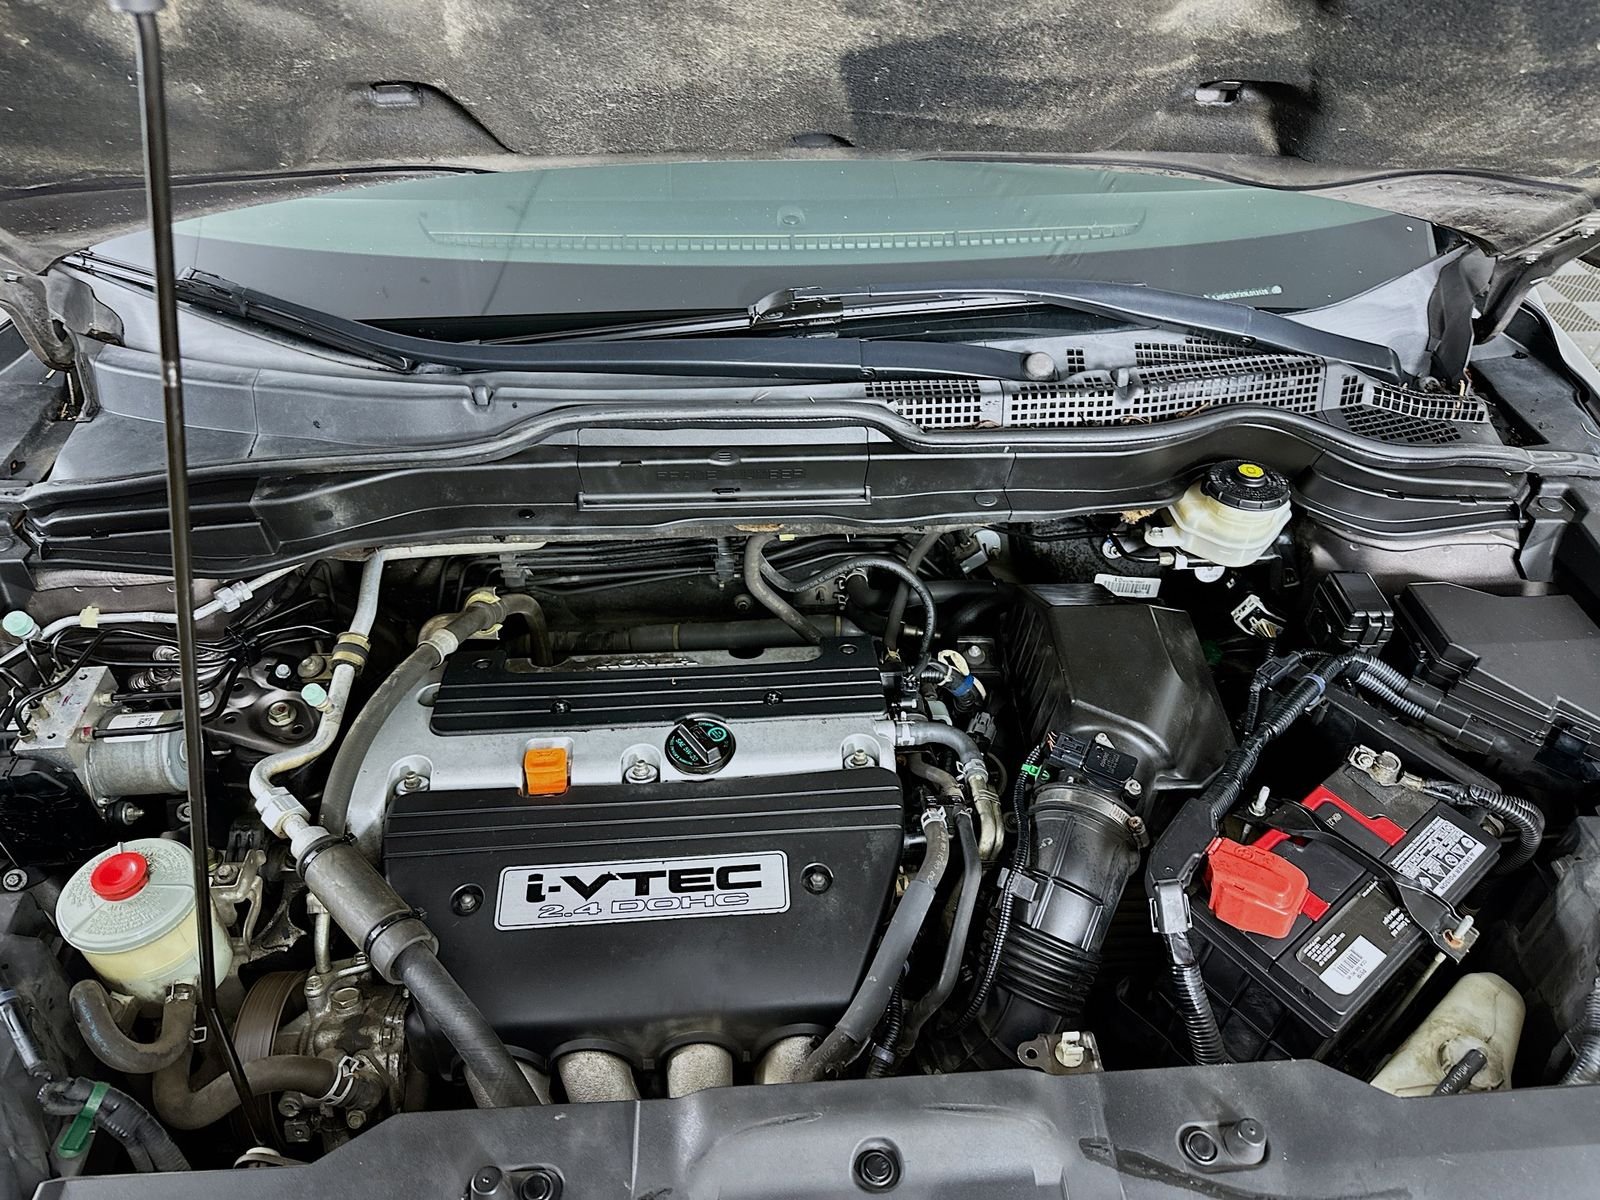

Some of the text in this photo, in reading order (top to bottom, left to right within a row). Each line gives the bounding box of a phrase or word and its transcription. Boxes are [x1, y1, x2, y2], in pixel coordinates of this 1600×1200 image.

[526, 864, 762, 903] i-VTEC
[1439, 855, 1472, 890] DANGER POISON
[538, 893, 749, 918] 2.4 DOHC
